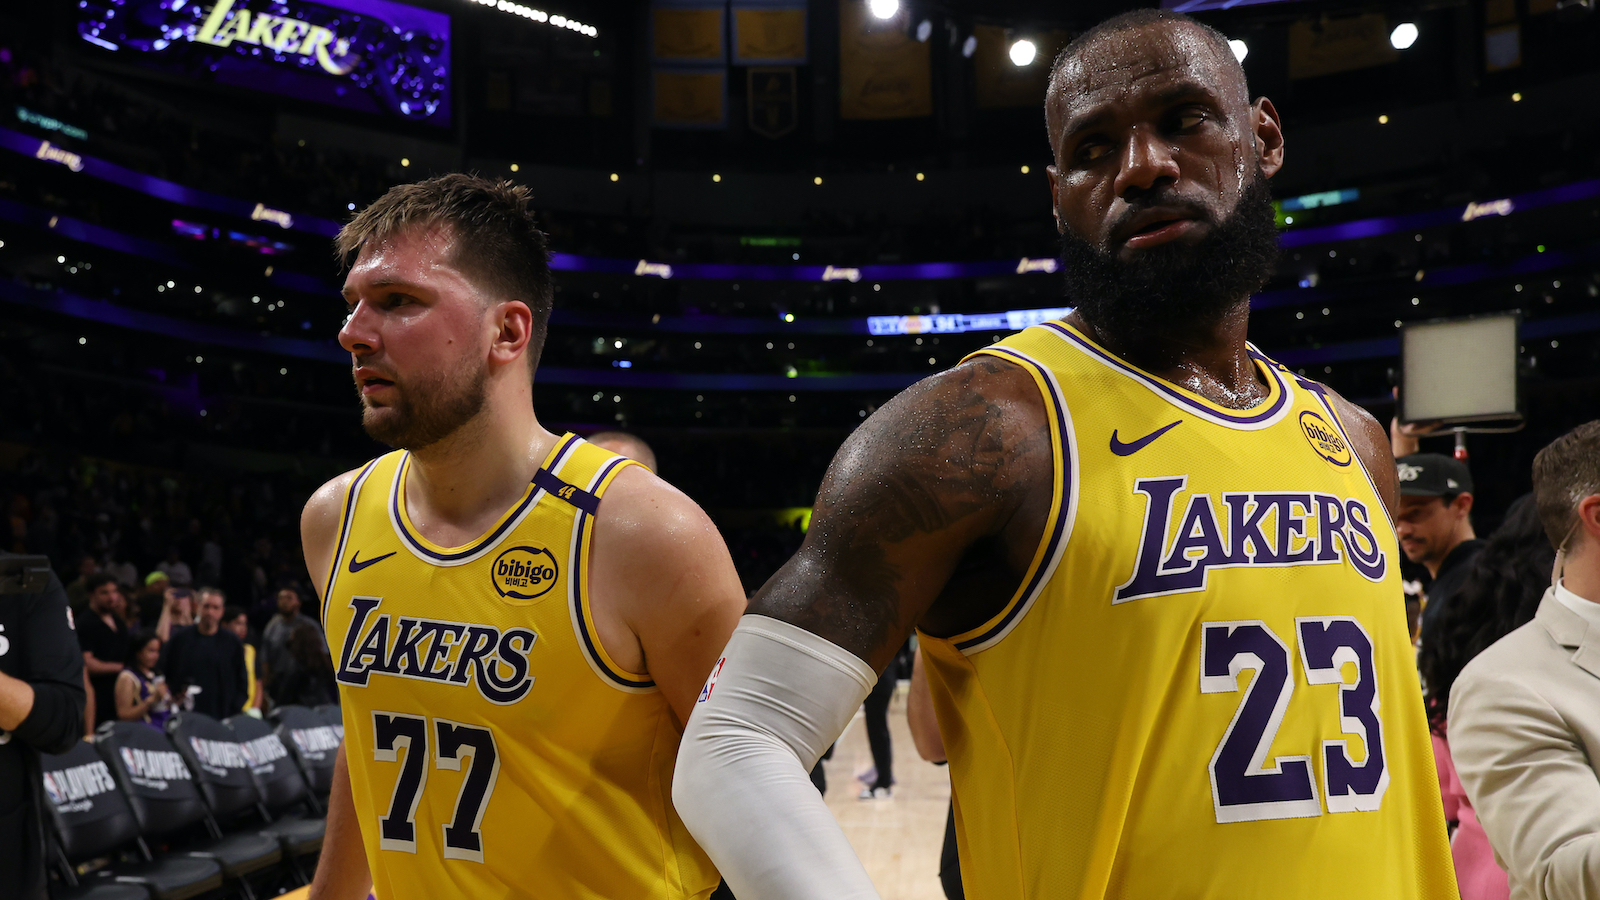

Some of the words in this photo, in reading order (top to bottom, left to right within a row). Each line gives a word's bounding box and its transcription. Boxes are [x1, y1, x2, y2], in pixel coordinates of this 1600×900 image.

[1303, 421, 1345, 452] bibigo
[558, 485, 577, 499] 44
[497, 559, 554, 585] bibigo
[1111, 474, 1386, 605] LAKERS
[505, 577, 528, 587] 비비고
[336, 596, 539, 706] LAKERS
[1200, 615, 1390, 824] 23
[371, 710, 501, 864] 77
